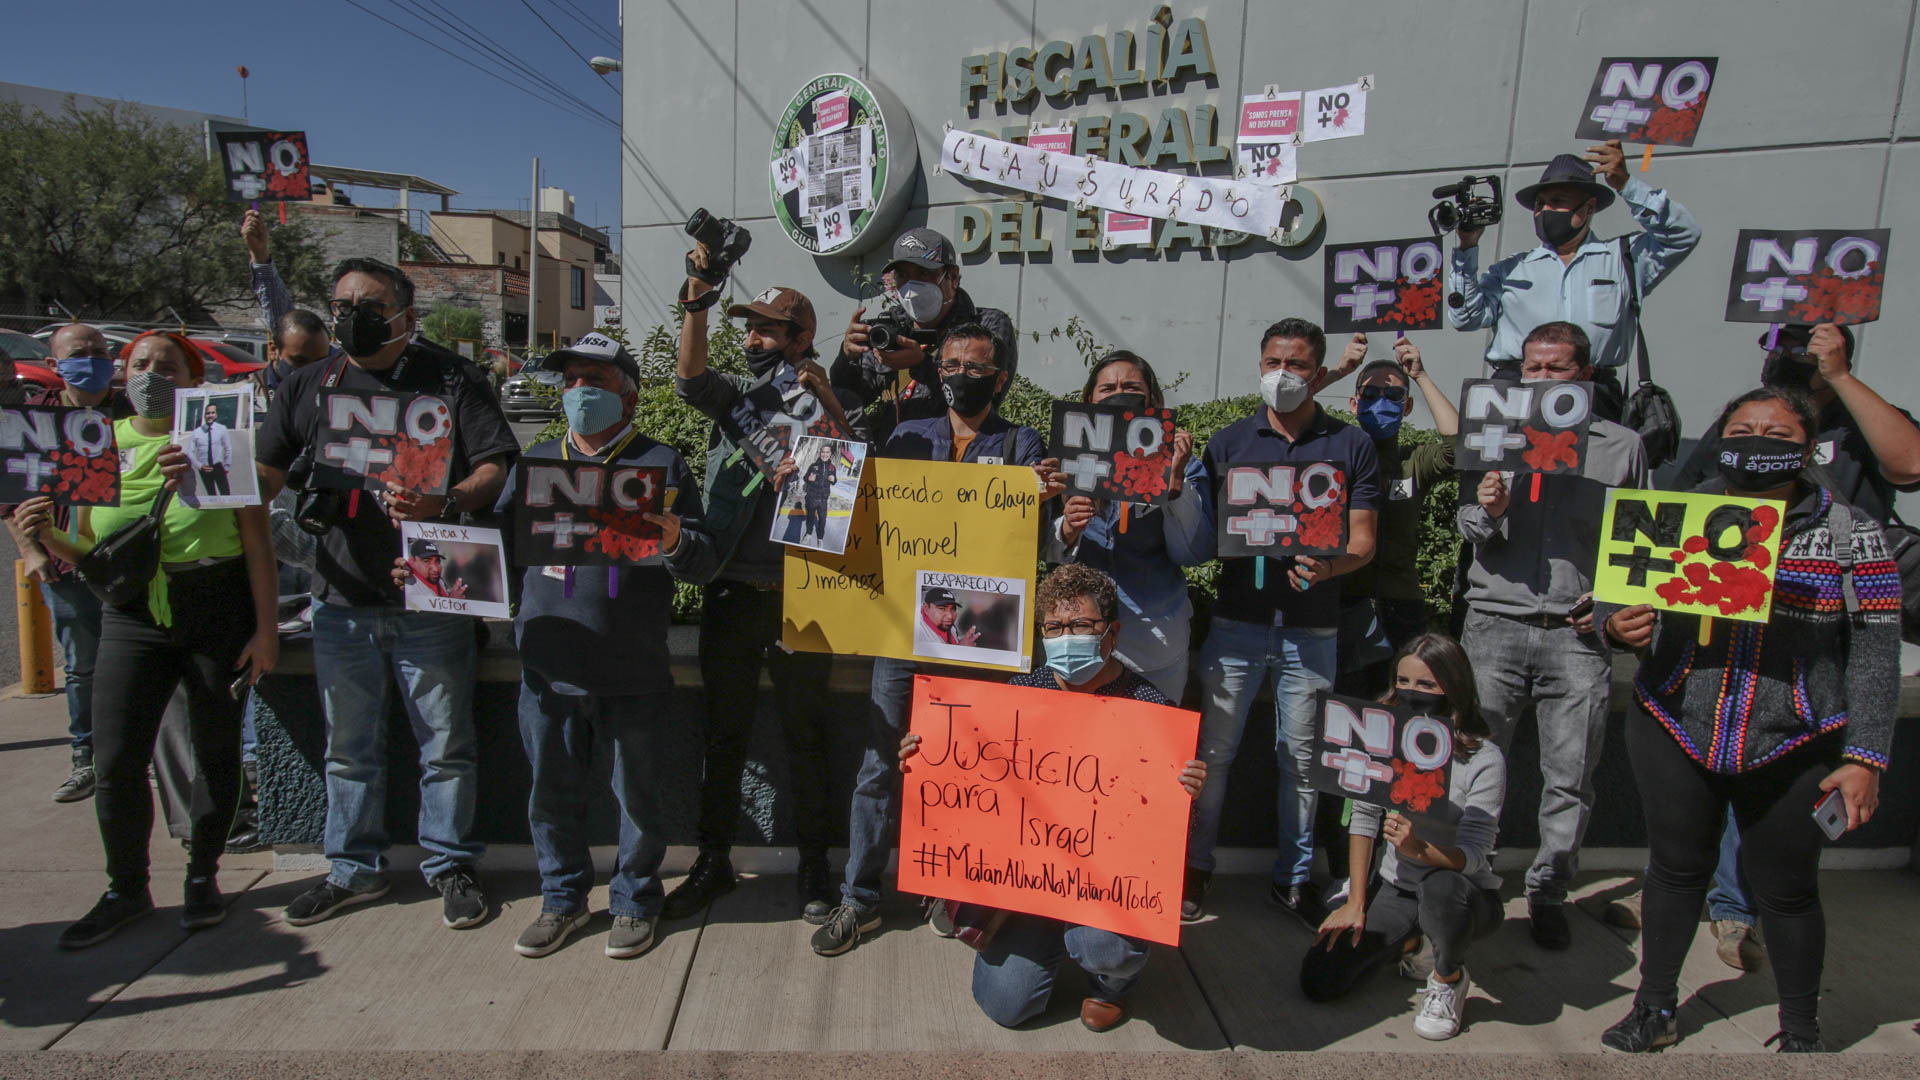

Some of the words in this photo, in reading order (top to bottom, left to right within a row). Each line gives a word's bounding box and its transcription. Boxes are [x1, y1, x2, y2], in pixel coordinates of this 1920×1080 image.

[960, 5, 1217, 108] FISCALÍA
[1318, 92, 1350, 113] NO
[1600, 59, 1711, 110] NO
[772, 108, 797, 158] SCALIA
[795, 76, 843, 107] GENERAL
[965, 103, 1231, 168] ERAL
[226, 139, 301, 177] NO
[779, 156, 796, 174] NO
[1251, 143, 1280, 164] NO
[822, 211, 840, 229] NO
[954, 202, 1051, 253] DEL
[1334, 241, 1443, 284] NO
[1746, 236, 1881, 281] NO
[328, 394, 453, 446] NO
[1466, 383, 1590, 428] NO
[0, 408, 113, 458] NO
[1062, 410, 1164, 457] NO
[526, 465, 656, 511] NO
[1227, 462, 1343, 510] NO
[1744, 460, 1802, 473] ágora
[855, 475, 944, 513] aparecido
[957, 487, 977, 502] en
[985, 476, 1036, 519] Celaya
[876, 519, 958, 561] Manuel
[1610, 498, 1762, 562] NO
[796, 549, 885, 601] Jiménez
[923, 572, 1009, 594] DESAPARECIDO
[919, 701, 1110, 797] Justicia
[1322, 699, 1453, 771] NO
[919, 780, 1001, 827] para
[1018, 796, 1098, 858] Israel
